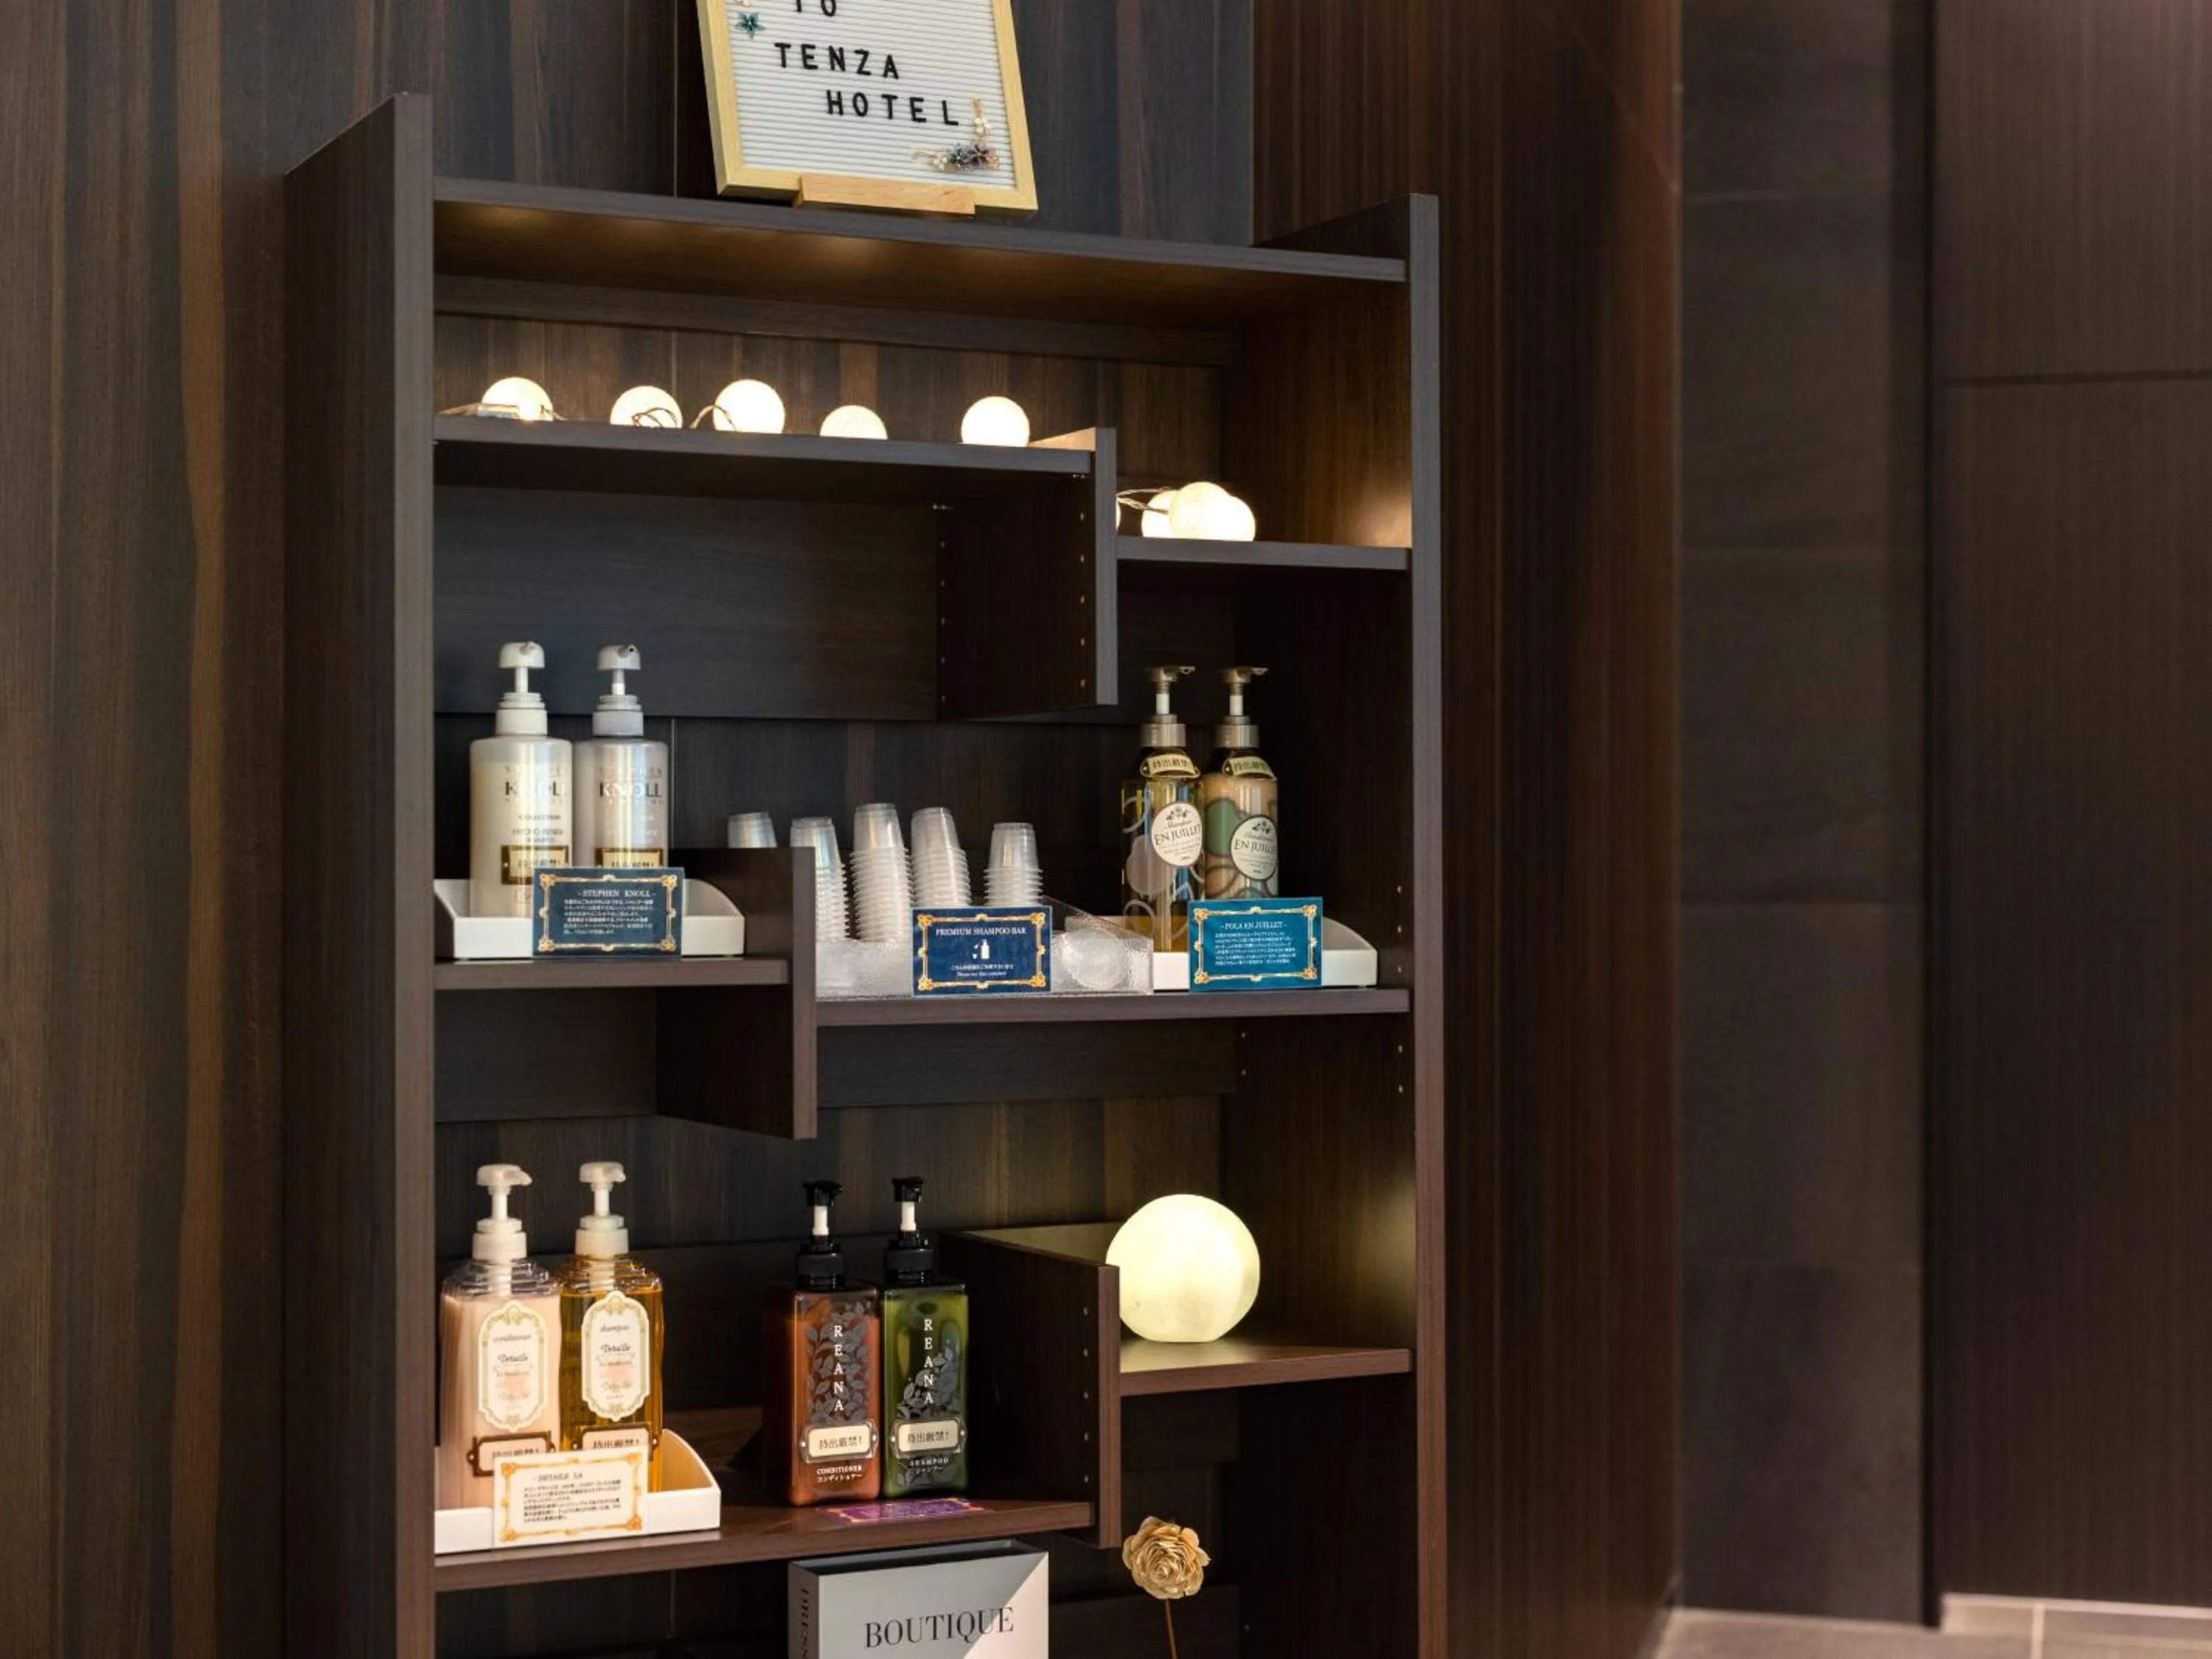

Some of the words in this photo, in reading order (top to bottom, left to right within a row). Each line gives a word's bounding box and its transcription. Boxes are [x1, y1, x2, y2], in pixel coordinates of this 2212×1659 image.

[774, 42, 900, 80] TENZA
[827, 89, 959, 126] HOTEL
[1155, 832, 1170, 846] EN
[1234, 838, 1250, 850] EN
[936, 928, 973, 936] PREMIUM
[973, 927, 1010, 936] SHAMPOO
[833, 1324, 845, 1412] REANA
[924, 1318, 934, 1404] REANA
[816, 1464, 862, 1475] CONDITIONER
[864, 1606, 1015, 1649] BOUTIQUE
